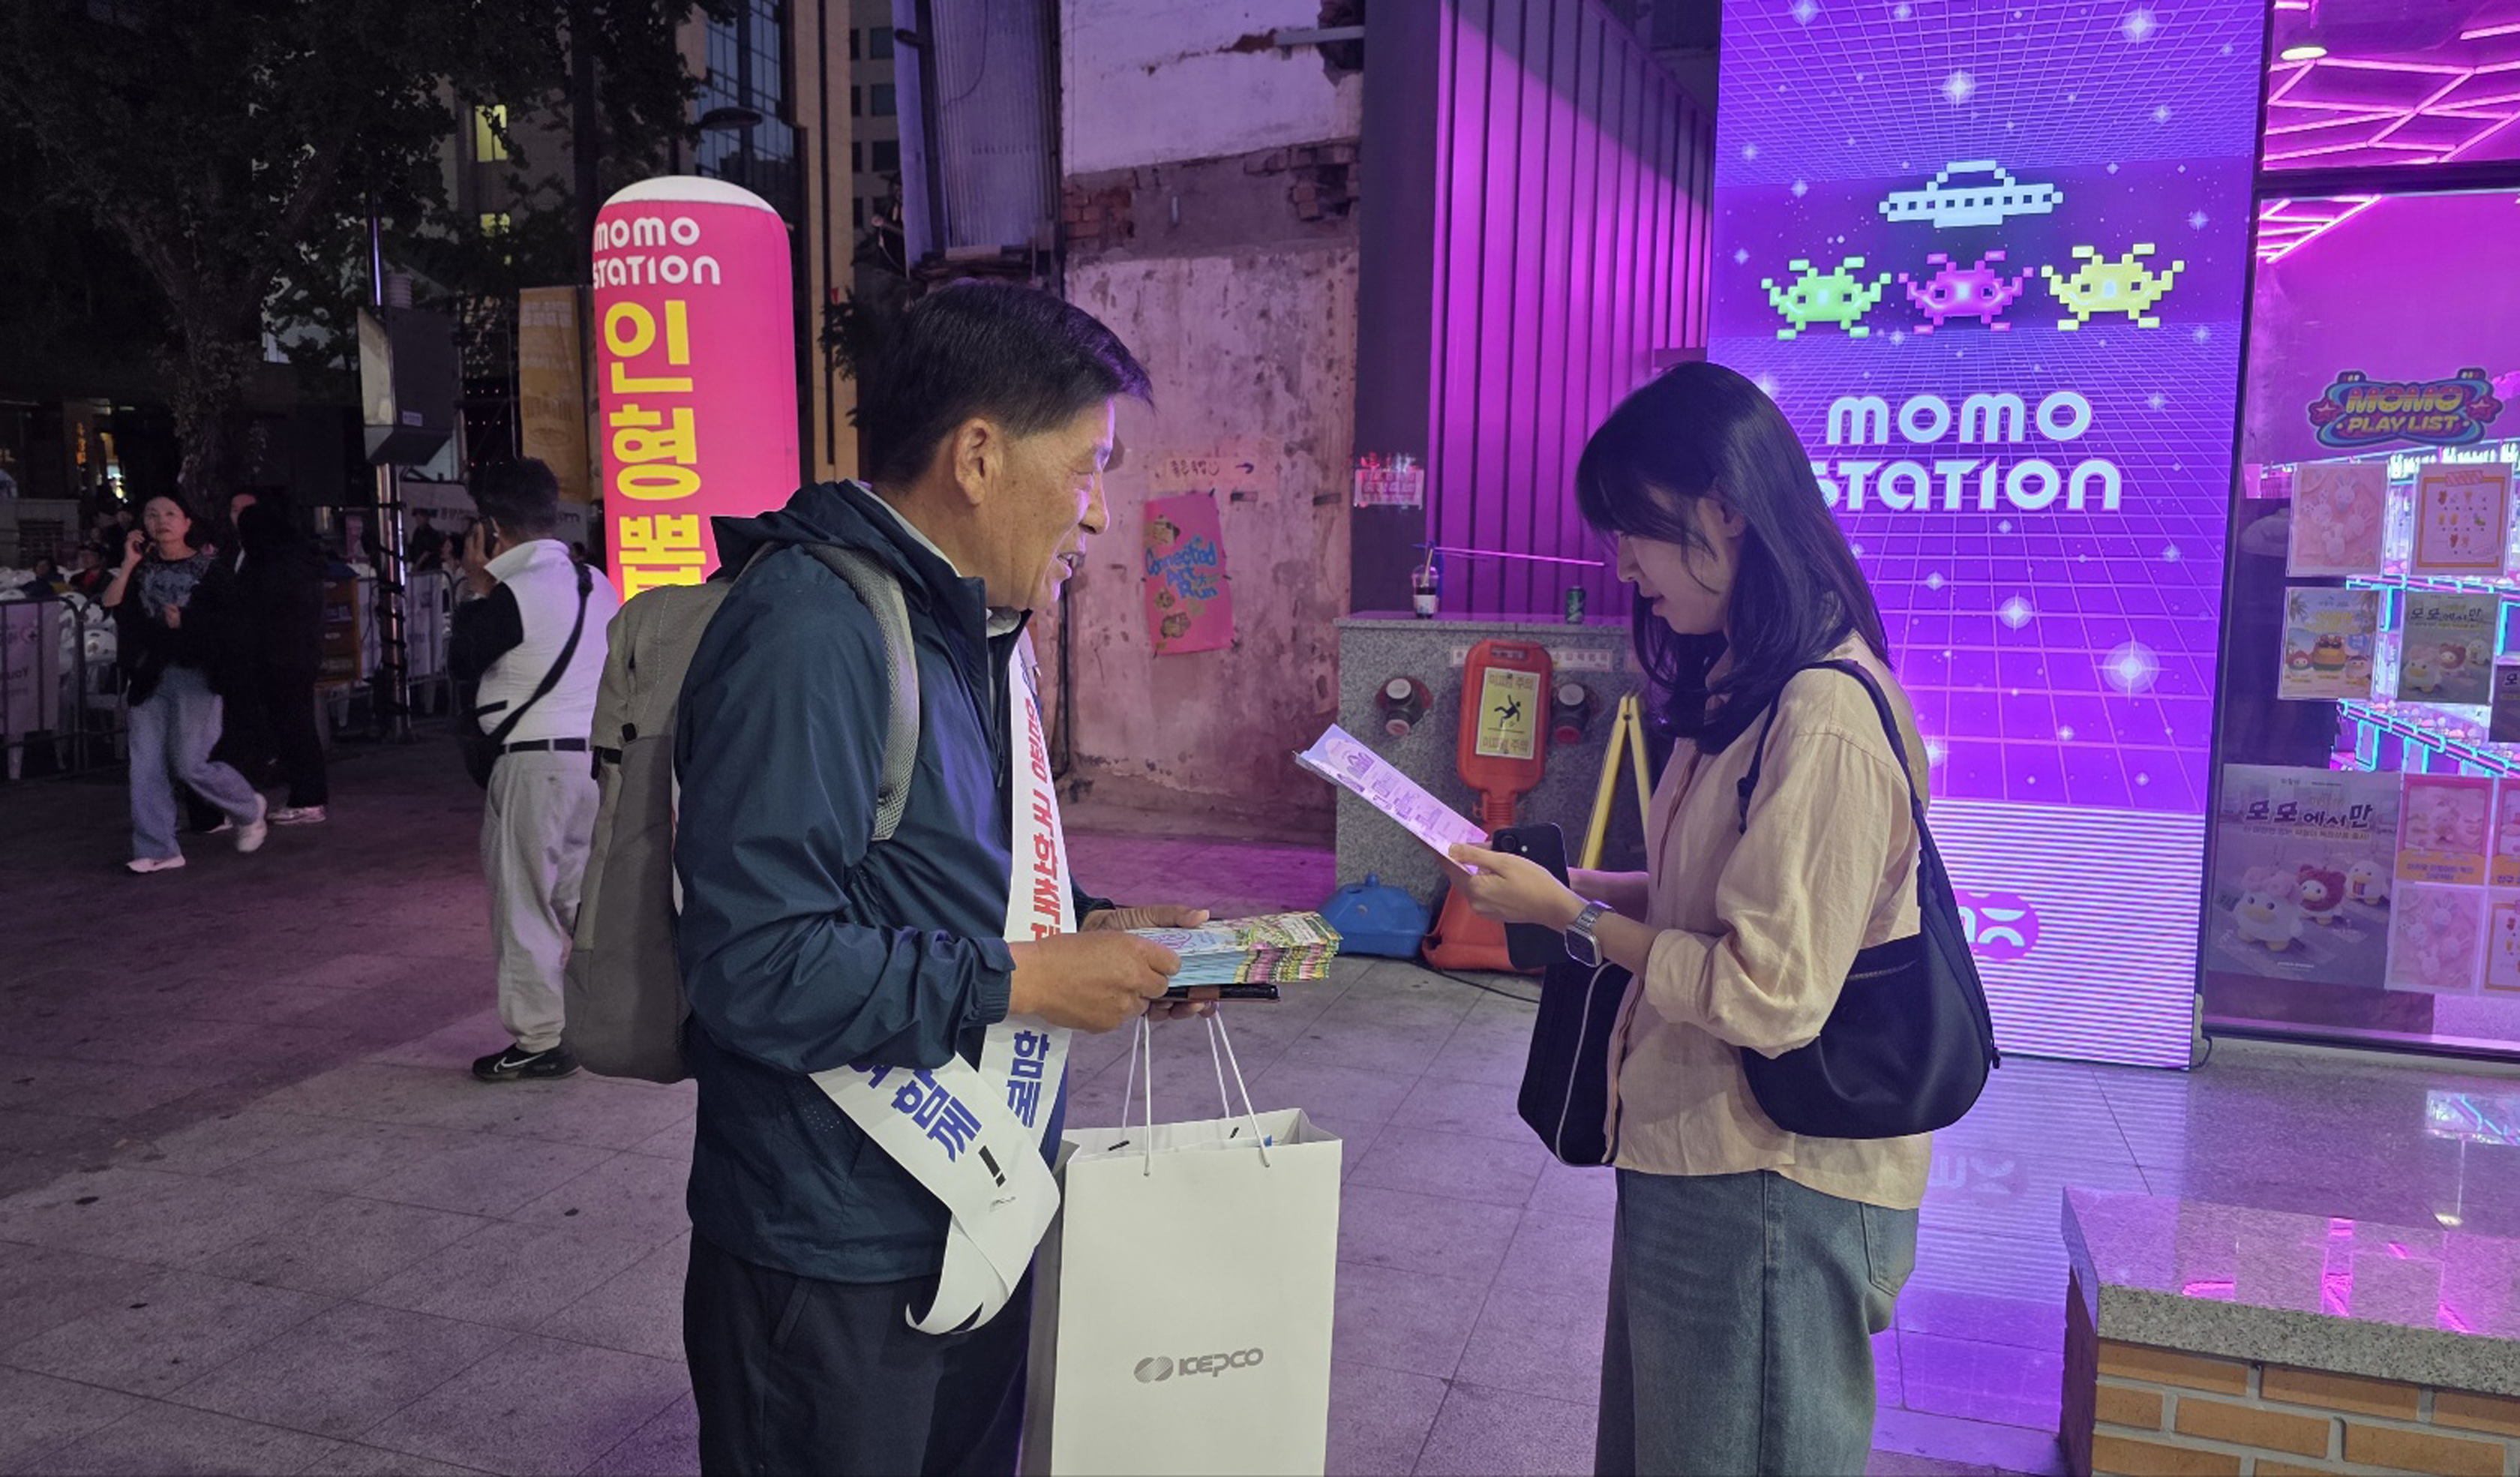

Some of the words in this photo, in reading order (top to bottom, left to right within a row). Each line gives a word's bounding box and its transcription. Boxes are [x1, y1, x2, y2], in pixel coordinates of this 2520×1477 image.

[2346, 386, 2464, 413] MOMO
[2348, 416, 2405, 433] PLAY
[2408, 416, 2459, 431] LIST
[2246, 800, 2373, 828] 모모에서만
[1179, 1348, 1264, 1377] KEPCO
